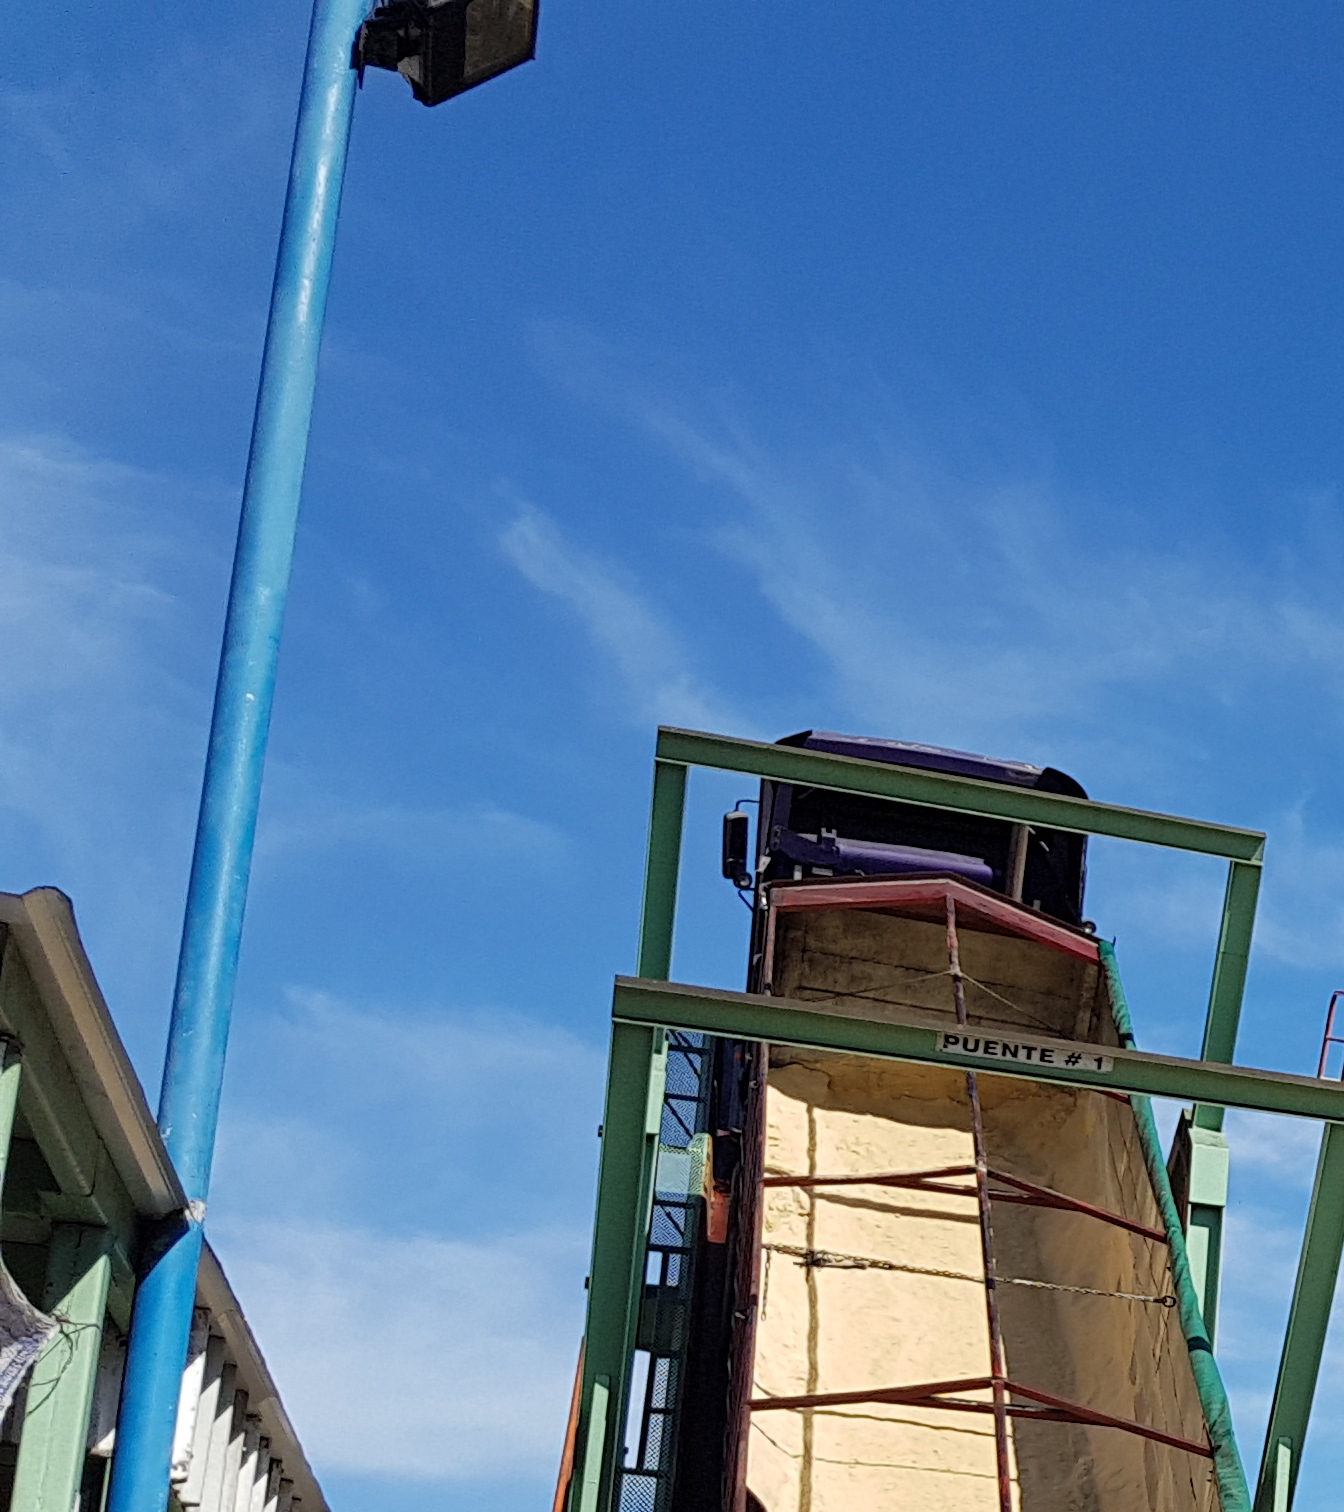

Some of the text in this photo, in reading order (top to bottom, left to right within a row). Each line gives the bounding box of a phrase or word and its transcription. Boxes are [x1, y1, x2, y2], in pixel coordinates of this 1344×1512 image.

[943, 1034, 1103, 1070] PUENTE # 1
